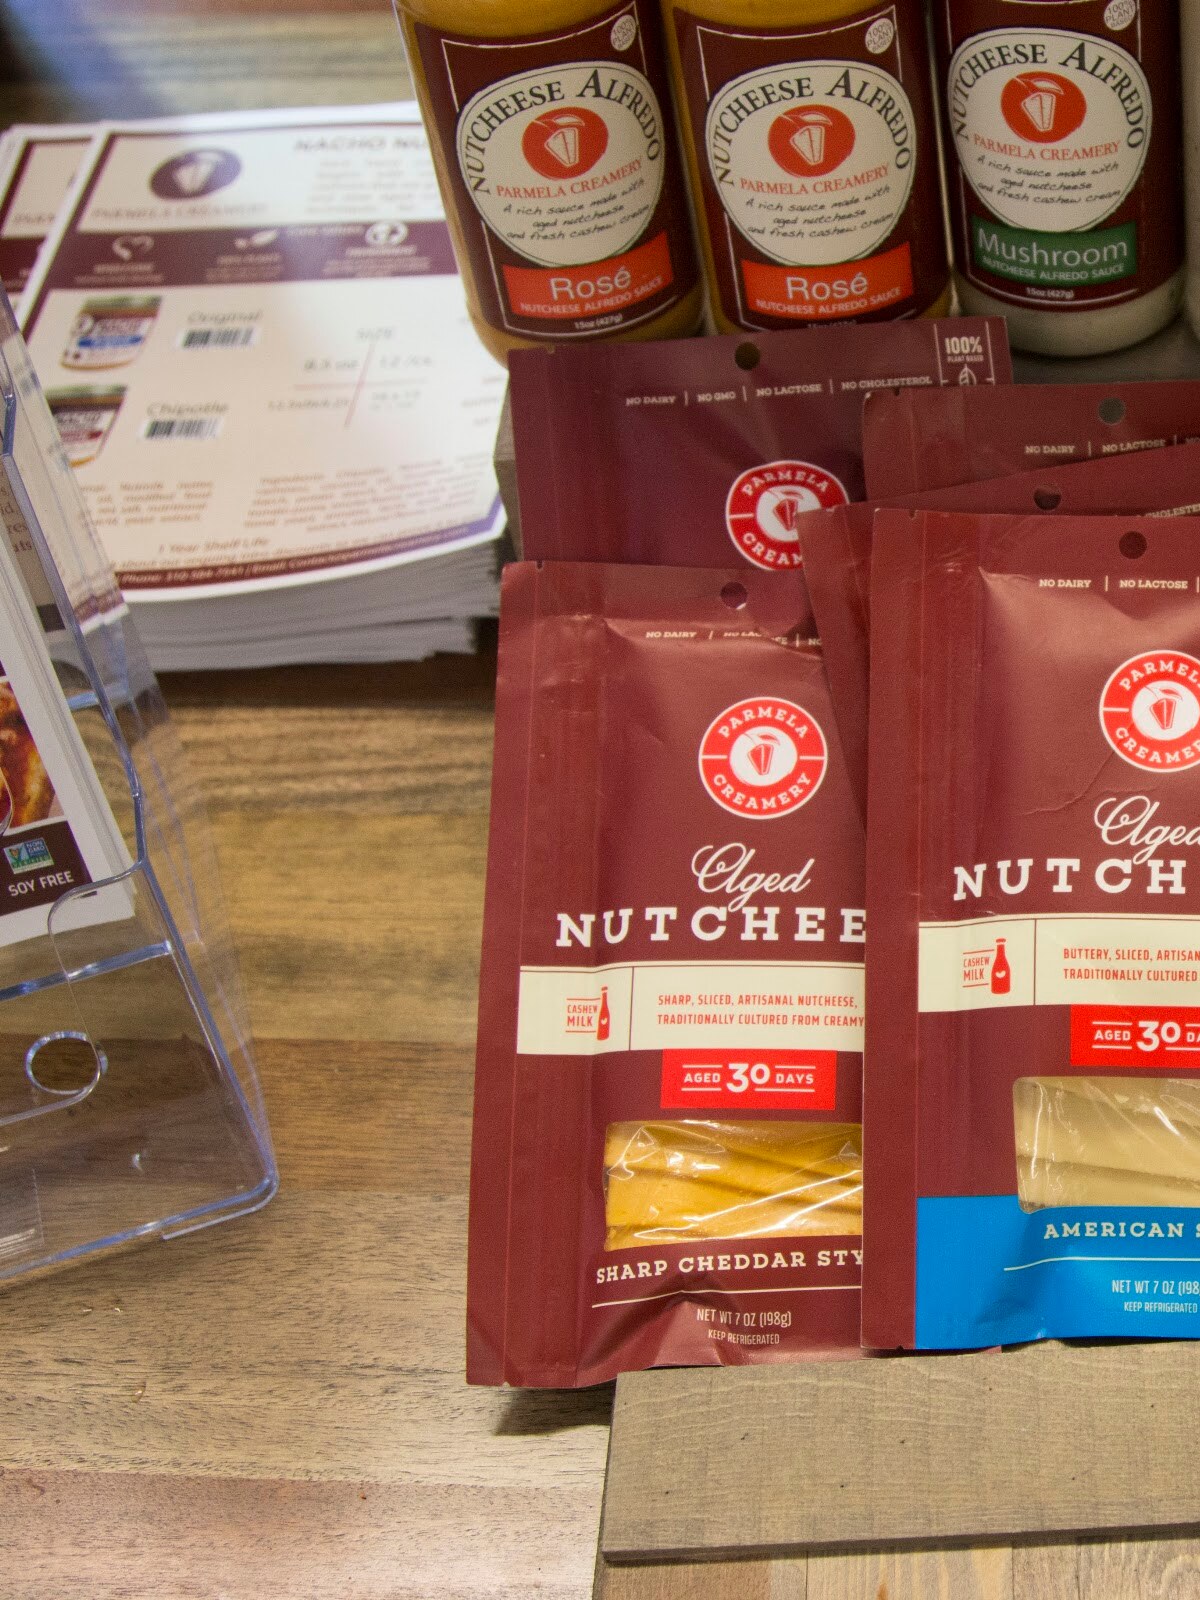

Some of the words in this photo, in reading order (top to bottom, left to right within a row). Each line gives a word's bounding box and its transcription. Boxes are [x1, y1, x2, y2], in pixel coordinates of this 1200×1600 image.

[955, 44, 1046, 140] NUTCHEESE
[1059, 42, 1144, 148] ALFREDO
[467, 81, 565, 194] NUTCHEESE
[577, 69, 659, 161] ALFREDO
[715, 77, 813, 186] NUTCHEESE
[825, 69, 910, 169] ALFREDO
[974, 133, 1035, 160] PARMELA
[1040, 141, 1121, 160] CREAMERY
[978, 228, 1127, 266] Mushroom
[550, 267, 631, 300] Rosé
[786, 273, 868, 301] Rosé
[946, 337, 982, 354] 100%
[742, 469, 829, 495] PARMELA
[1039, 579, 1054, 587] NO
[1056, 579, 1091, 588] DAIRY
[1120, 580, 1134, 588] NO
[1137, 580, 1188, 589] LACTOSE
[718, 706, 808, 738] PARMELA
[713, 773, 811, 809] CREAMERY
[8, 880, 35, 896] SOY
[39, 871, 74, 888] FREE
[692, 843, 814, 912] Aged
[556, 907, 866, 948] NUTCHEE
[963, 957, 990, 969] CASHEW
[1064, 948, 1113, 962] BUTTERY,
[1116, 949, 1153, 963] SLICED,
[963, 969, 985, 981] MILK
[1064, 969, 1143, 982] TRADITIONALLY
[1147, 969, 1198, 982] CULTURED
[567, 1004, 598, 1014] CASHEW
[658, 994, 695, 1006] SHARP,
[698, 994, 734, 1006] SLICED,
[738, 994, 794, 1006] ARTISANAL
[798, 994, 857, 1008] NUTCHEESE,
[567, 1015, 593, 1027] MILK
[658, 1014, 734, 1025] TRADITIONALLY
[738, 1014, 787, 1025] CULTURED
[792, 1015, 820, 1025] FROM
[824, 1015, 864, 1027] CREAMY
[1094, 1030, 1130, 1041] AGED
[1136, 1021, 1180, 1052] 30
[1044, 1223, 1183, 1239] AMERICAN
[597, 1260, 668, 1284] SHARP
[679, 1252, 806, 1273] CHEDDAR
[817, 1250, 862, 1267] STY
[1112, 1280, 1131, 1292] NET
[1134, 1280, 1149, 1293] WT
[1153, 1281, 1158, 1293] 7
[1162, 1281, 1175, 1294] OZ
[697, 1309, 716, 1323] NET
[719, 1312, 733, 1324] WT
[735, 1312, 741, 1325] 7
[744, 1313, 757, 1326] OZ
[760, 1311, 792, 1328] (198g)
[1124, 1302, 1141, 1312] KEEP
[1144, 1302, 1198, 1314] REFRIGERATED
